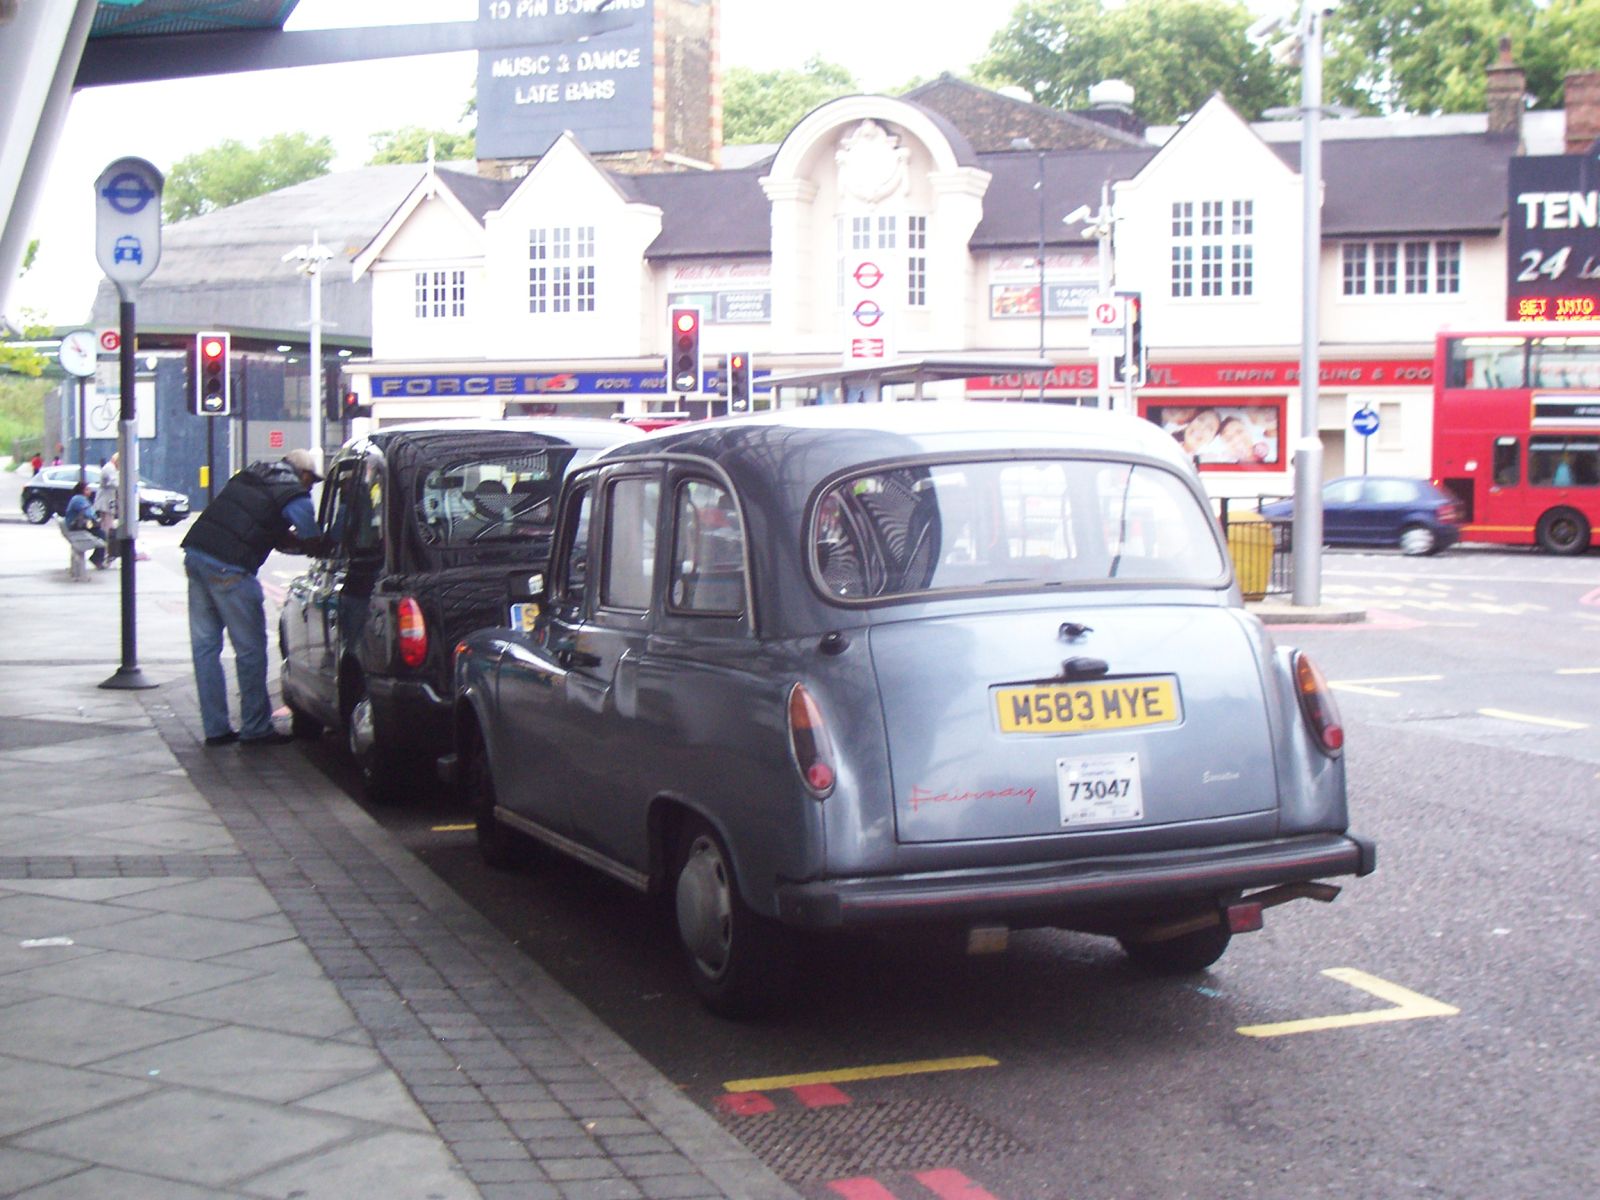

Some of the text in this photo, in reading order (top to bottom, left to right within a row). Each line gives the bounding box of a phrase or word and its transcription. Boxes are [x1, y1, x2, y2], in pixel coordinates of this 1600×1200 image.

[516, 0, 548, 18] PIN
[492, 48, 641, 77] MUSIC & DANCE
[515, 79, 616, 104] LATE BARS
[1517, 191, 1600, 229] TEN
[1517, 246, 1571, 282] 24
[382, 376, 516, 395] FORCE
[990, 368, 1094, 387] ROWANS
[1217, 369, 1276, 381] TENPIN
[1394, 367, 1432, 379] POO
[1069, 778, 1131, 801] 73047
